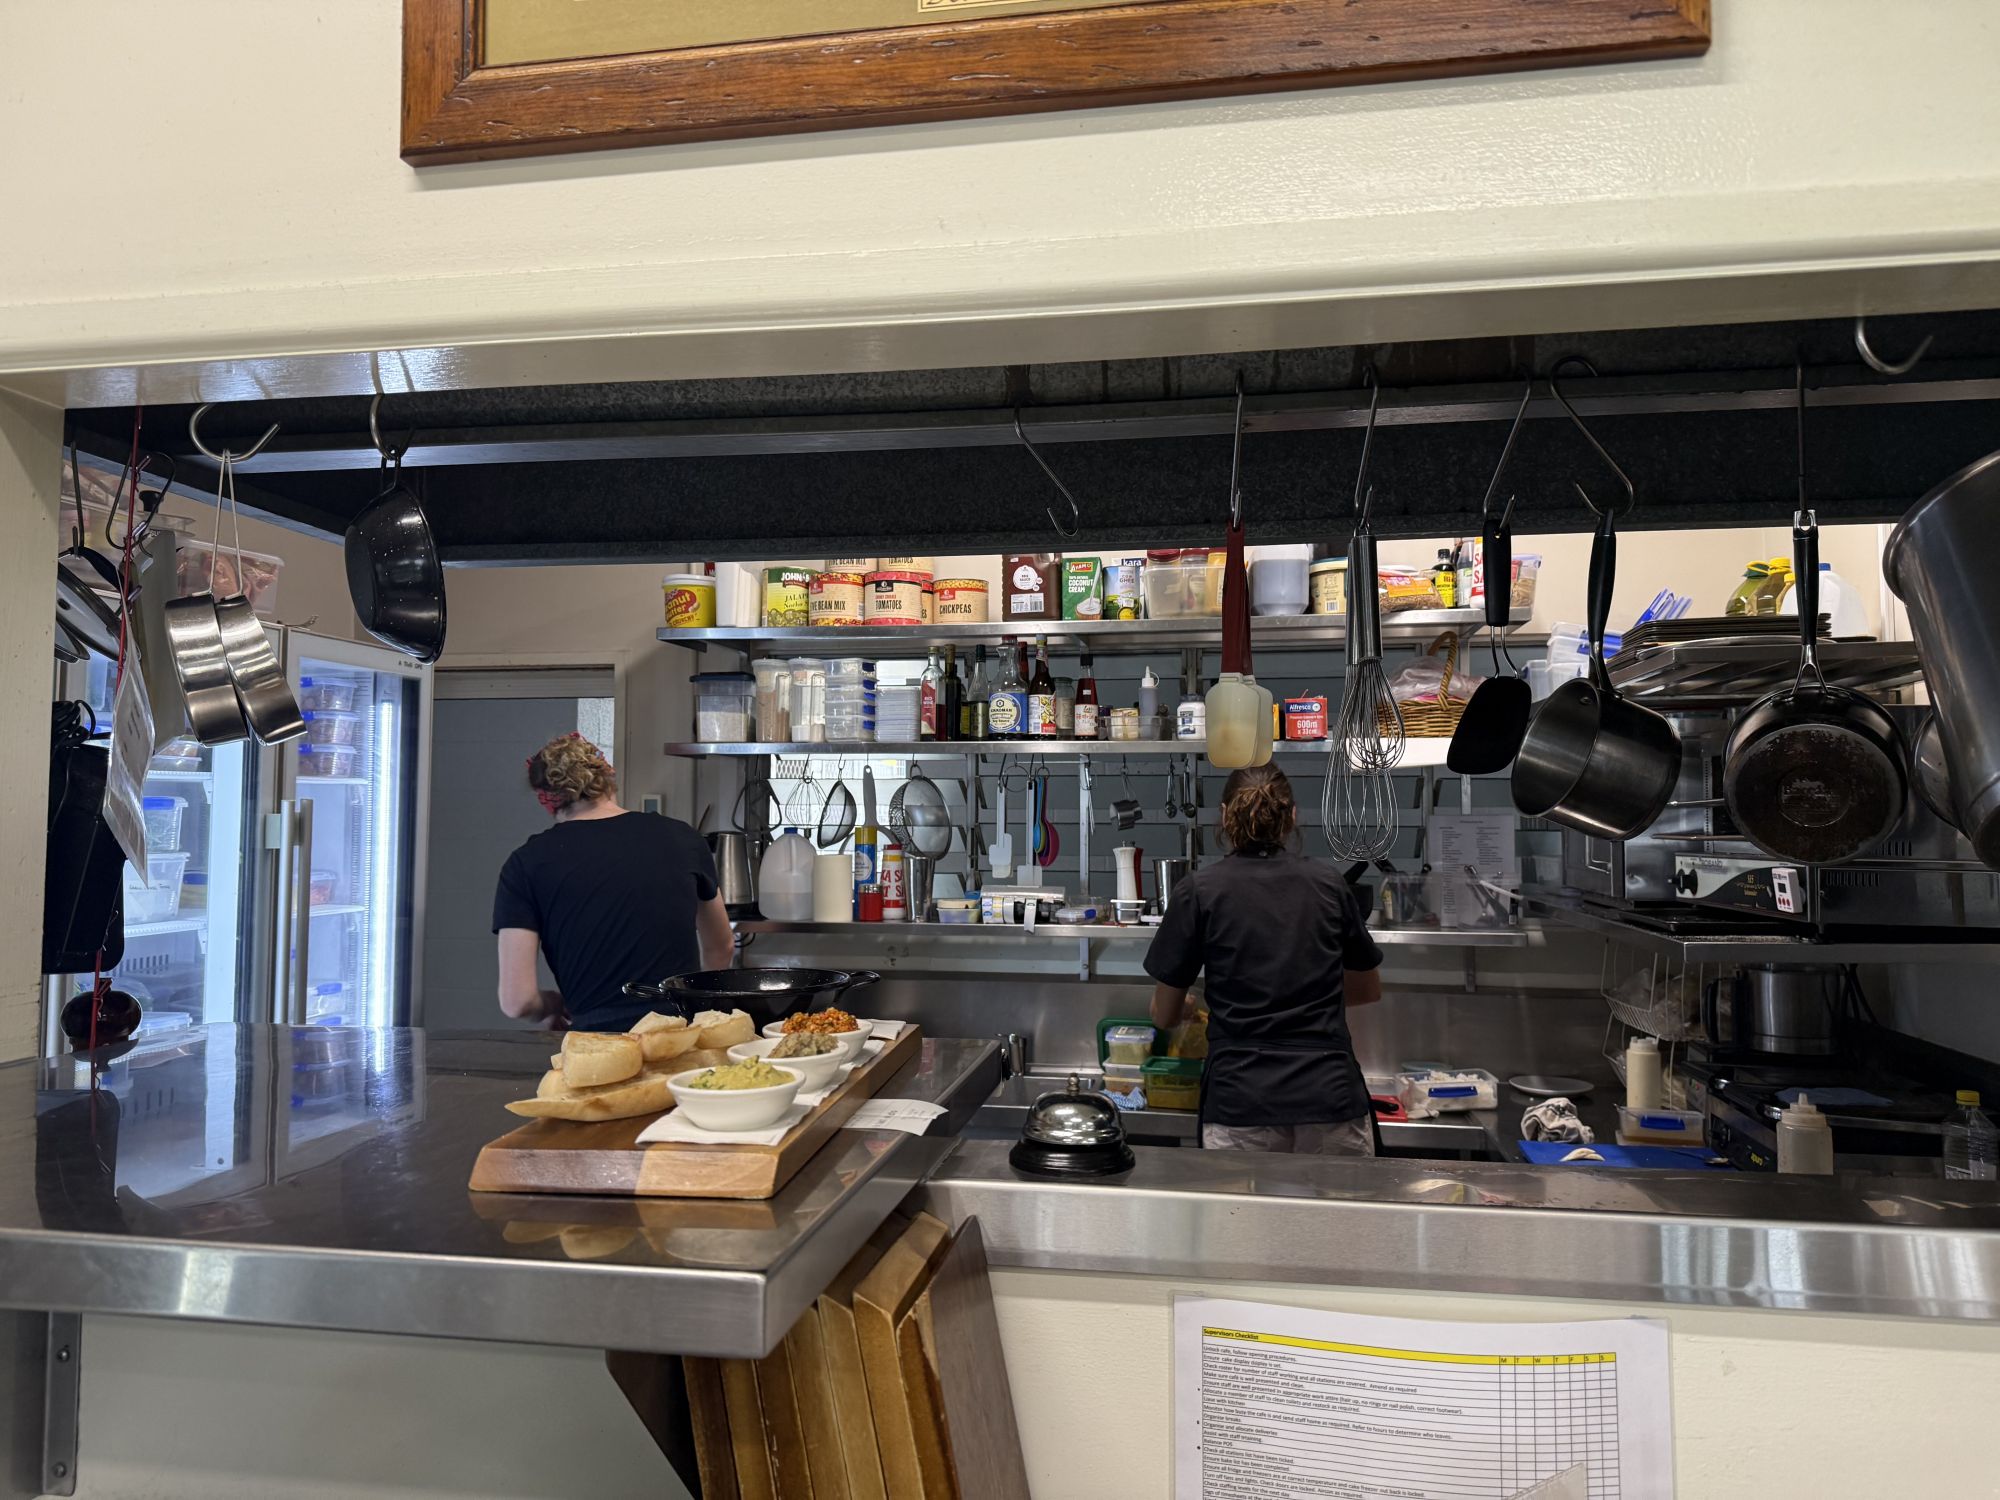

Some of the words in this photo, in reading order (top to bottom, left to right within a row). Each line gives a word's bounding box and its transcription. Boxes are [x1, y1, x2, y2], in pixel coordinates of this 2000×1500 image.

[888, 557, 914, 565] TOMATOES
[1123, 559, 1142, 567] kara
[1068, 579, 1093, 587] COCONUT
[818, 601, 833, 611] BEAN
[833, 600, 846, 611] MIX
[875, 599, 902, 611] TOMATOES
[939, 603, 972, 615] CHICKPEAS
[1289, 703, 1312, 711] Alfresco
[1296, 719, 1318, 729] 600m
[1203, 1327, 1234, 1338] Supervisors
[1235, 1331, 1259, 1339] Checklist
[1279, 1372, 1298, 1380] working
